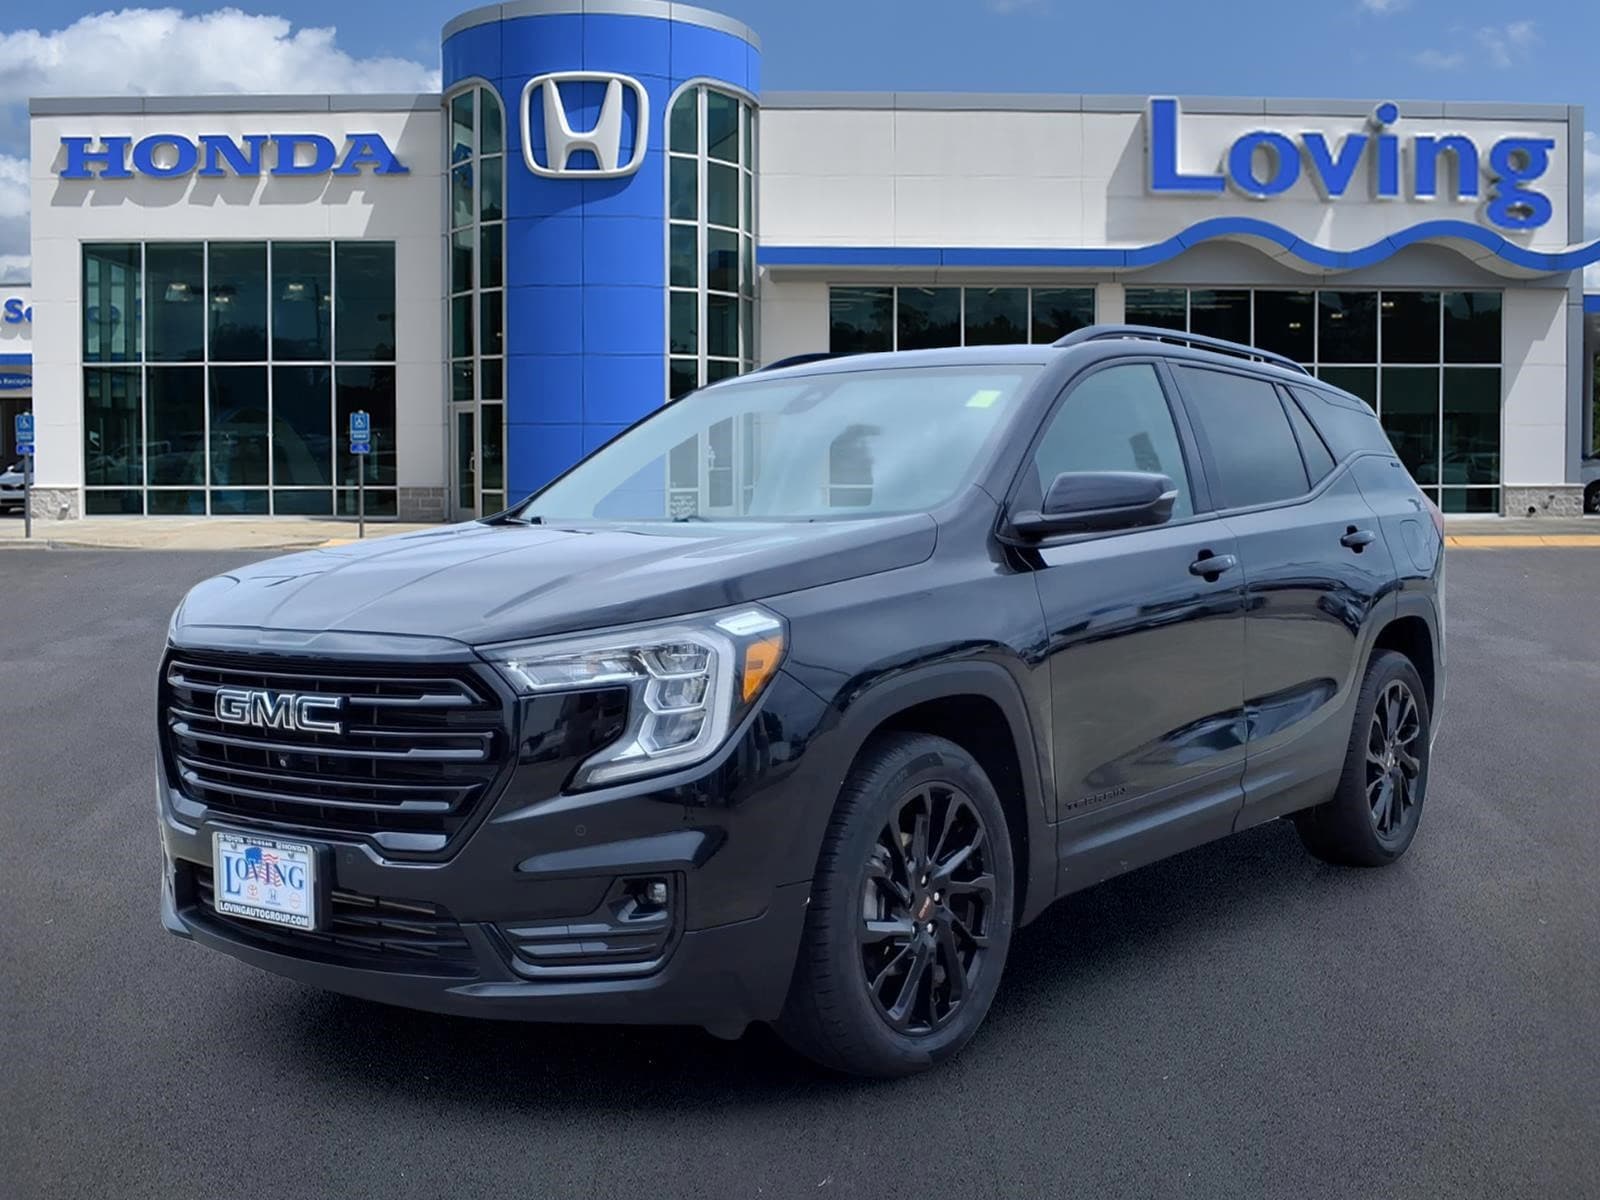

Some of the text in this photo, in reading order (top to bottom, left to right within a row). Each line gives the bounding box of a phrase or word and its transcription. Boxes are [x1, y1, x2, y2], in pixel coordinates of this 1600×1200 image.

[60, 133, 410, 180] HONDA
[1149, 97, 1556, 230] Loving
[215, 687, 343, 735] GMC
[224, 855, 304, 896] LOVING
[220, 902, 308, 925] LOVINGAUTOGROUP.COM
